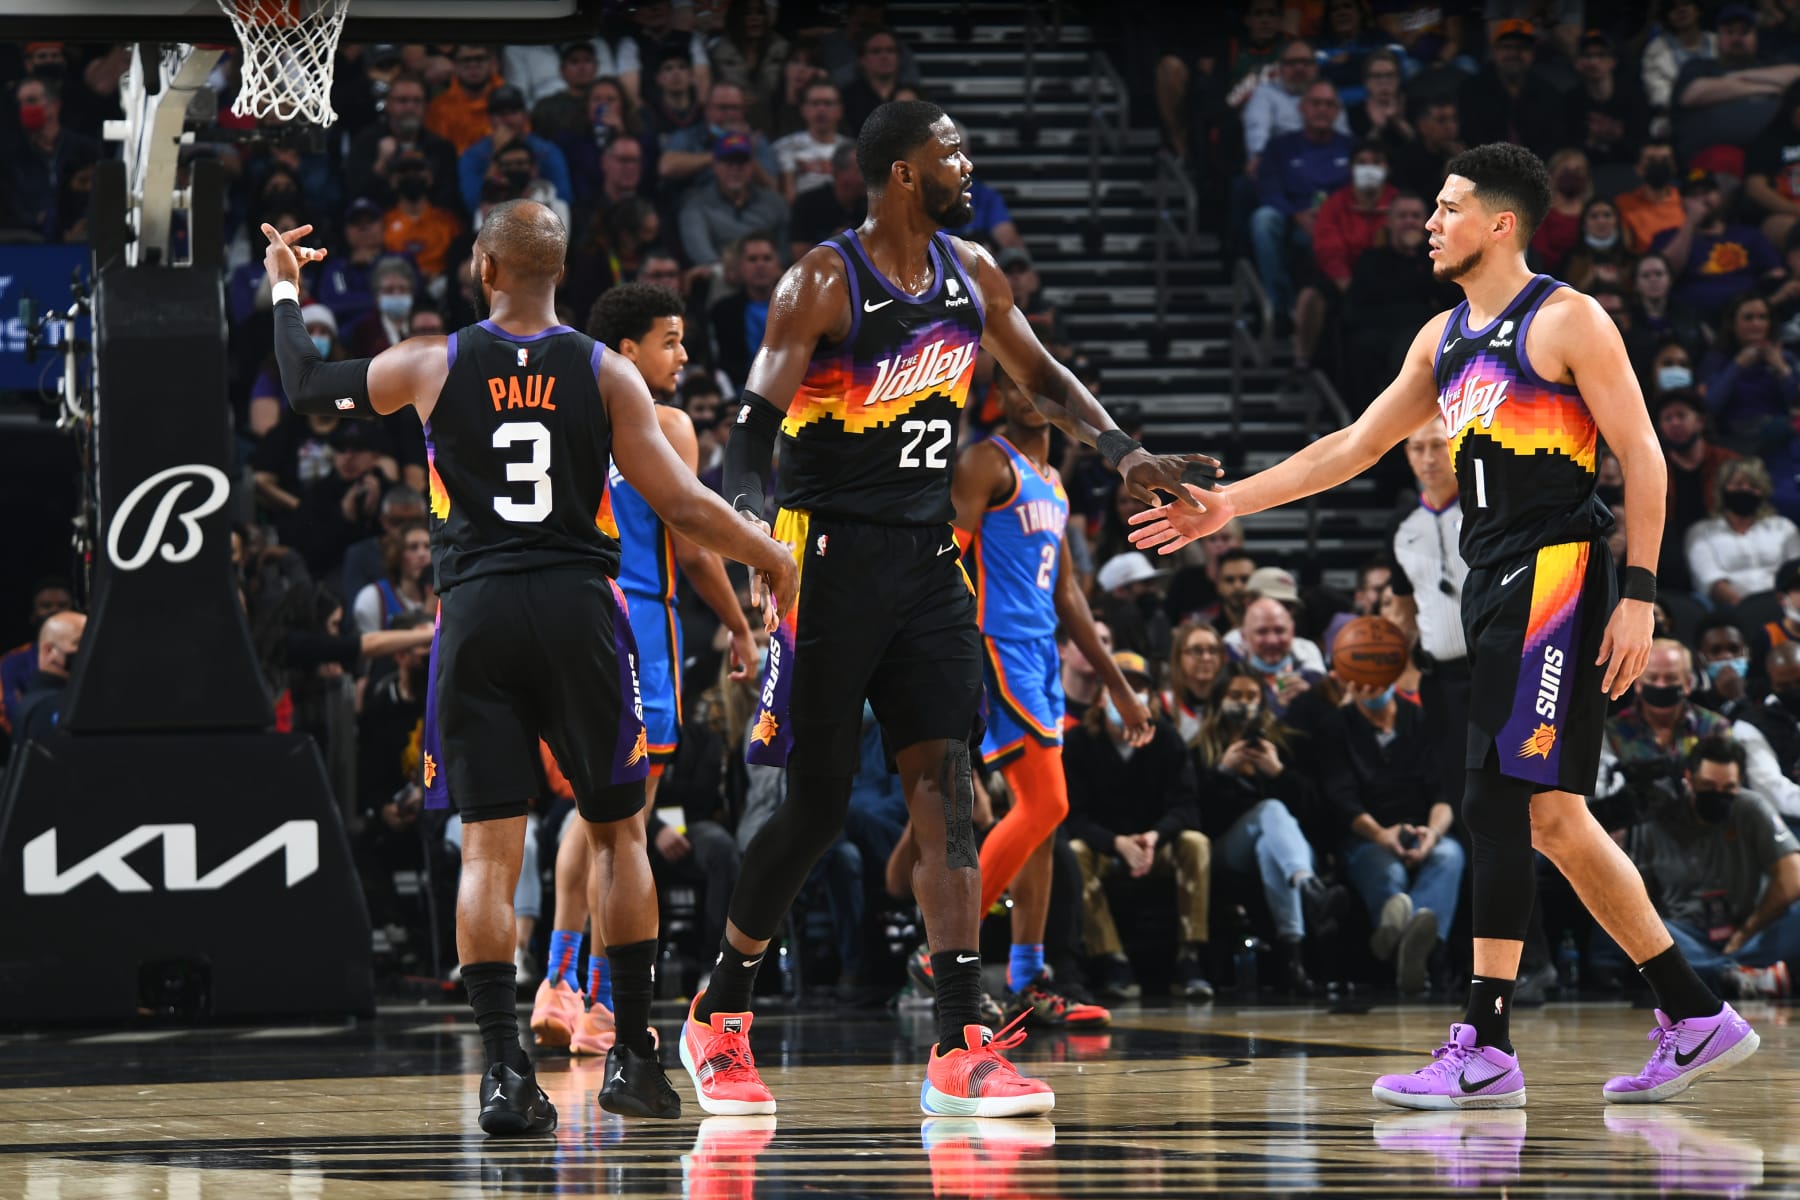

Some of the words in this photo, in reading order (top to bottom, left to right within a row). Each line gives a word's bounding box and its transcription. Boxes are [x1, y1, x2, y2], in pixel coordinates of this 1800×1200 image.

[945, 296, 969, 307] PayPal
[901, 354, 919, 368] THE
[1489, 339, 1513, 348] PayPal
[488, 374, 557, 412] PAUL
[863, 339, 975, 407] Valley
[1448, 388, 1462, 403] THE
[899, 419, 952, 469] 22
[492, 422, 553, 523] 3
[1473, 458, 1488, 509] 1
[1036, 543, 1057, 592] 2
[762, 636, 781, 708] SUNS
[1535, 645, 1564, 720] SUNS
